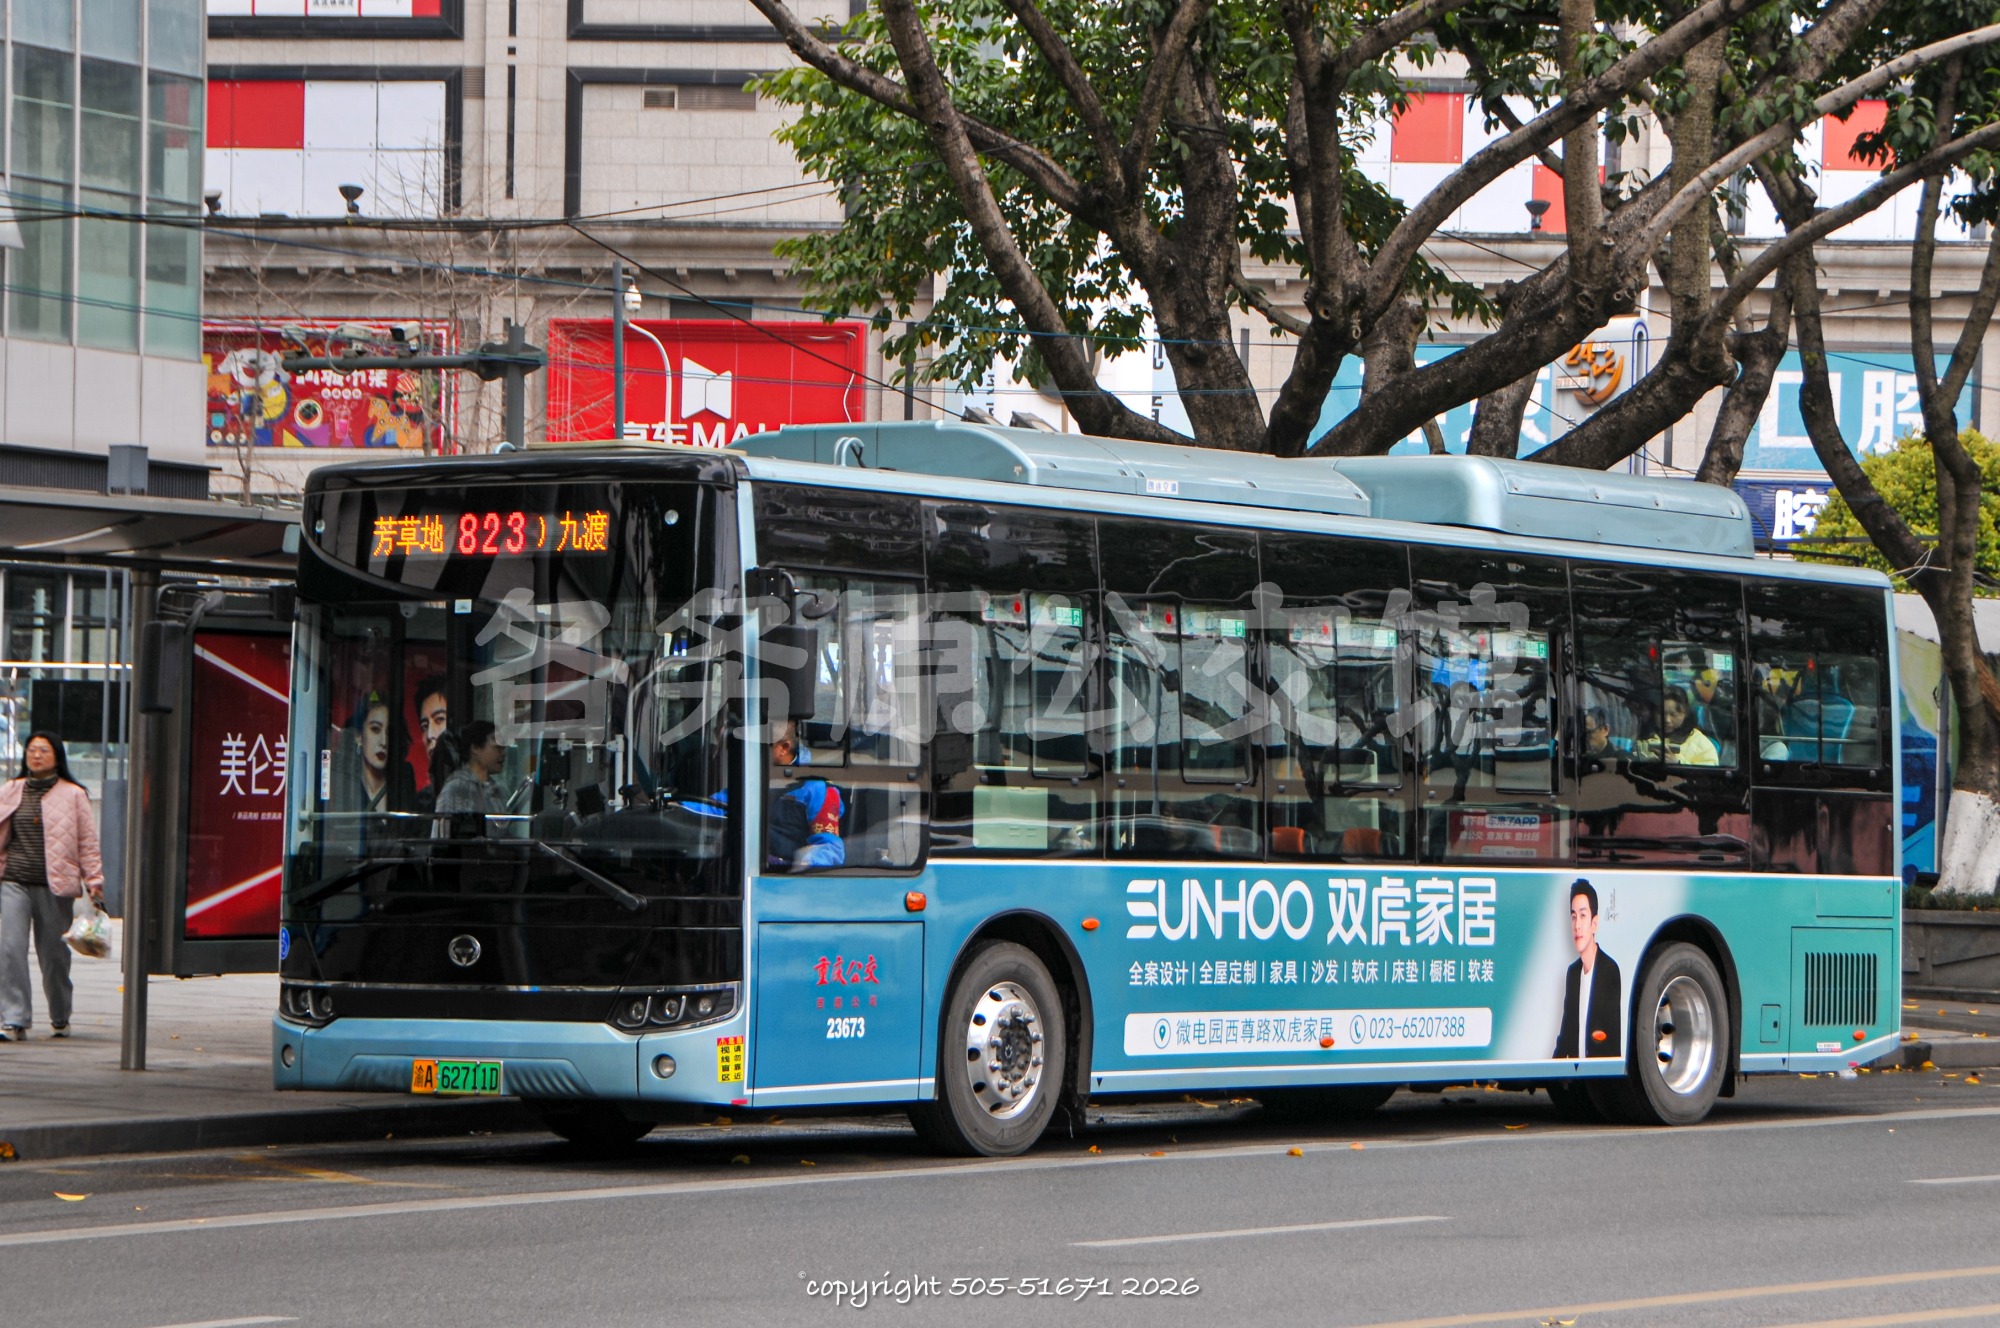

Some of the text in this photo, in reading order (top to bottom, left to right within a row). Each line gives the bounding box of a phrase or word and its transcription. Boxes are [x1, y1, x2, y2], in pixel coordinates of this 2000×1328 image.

[373, 509, 608, 556] 芳草地 823 九渡
[1327, 876, 1496, 946] 双虎家居
[814, 953, 879, 987] 重庆公交
[1129, 959, 1494, 987] 全案设计 全屋定制 家具 沙发 软床 床垫 橱柜 软装
[826, 1016, 866, 1039] 23673
[1176, 1016, 1466, 1045] 微电园西尊路双虎家居 023-65207388
[721, 1046, 730, 1081] 视线盲区
